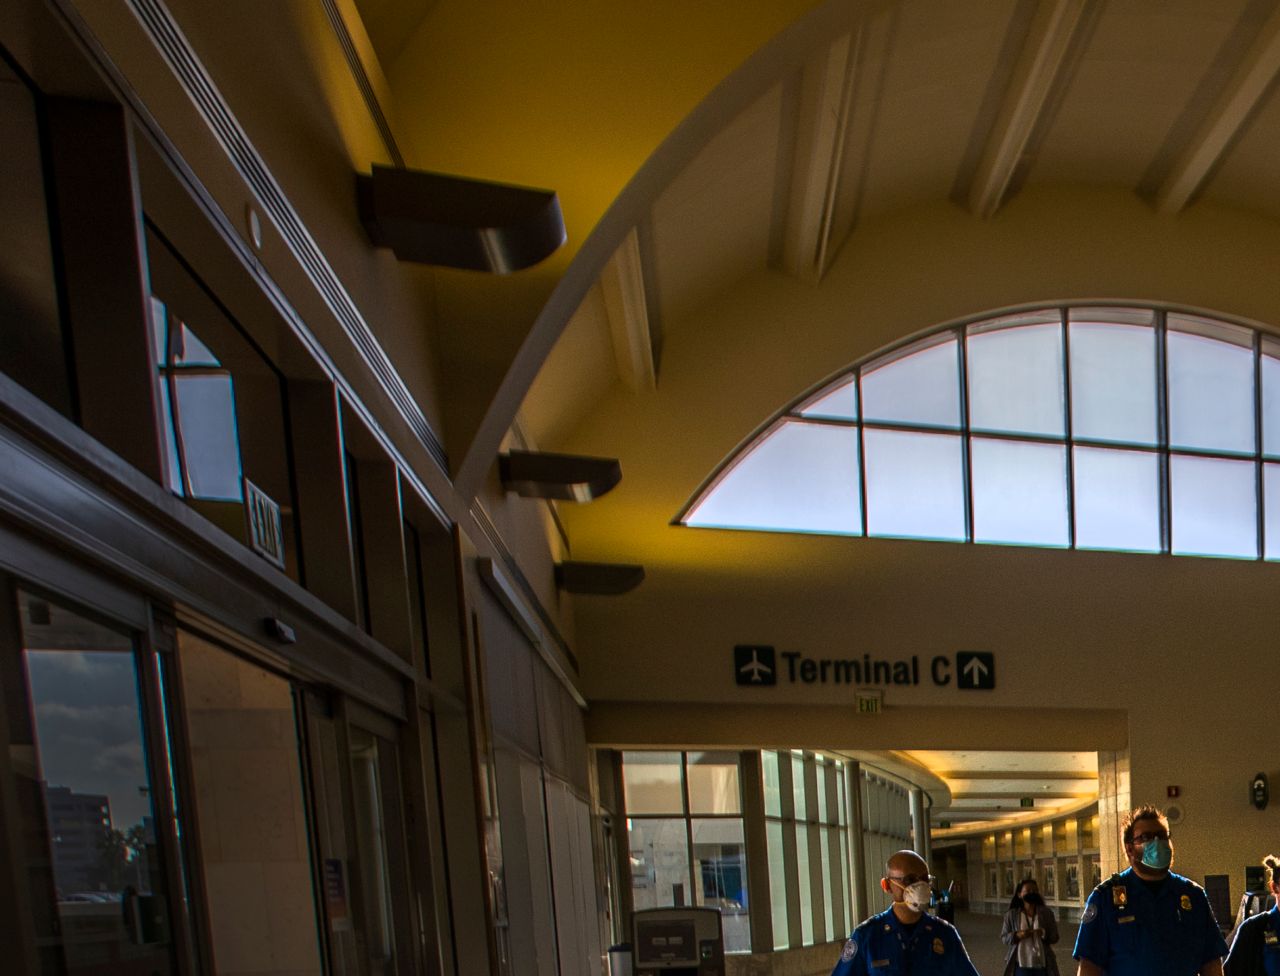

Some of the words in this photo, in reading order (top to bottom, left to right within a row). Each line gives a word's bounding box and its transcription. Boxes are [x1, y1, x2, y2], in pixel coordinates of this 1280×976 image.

[782, 652, 919, 685] Terminal
[931, 656, 950, 686] C
[859, 698, 878, 713] EXIT
